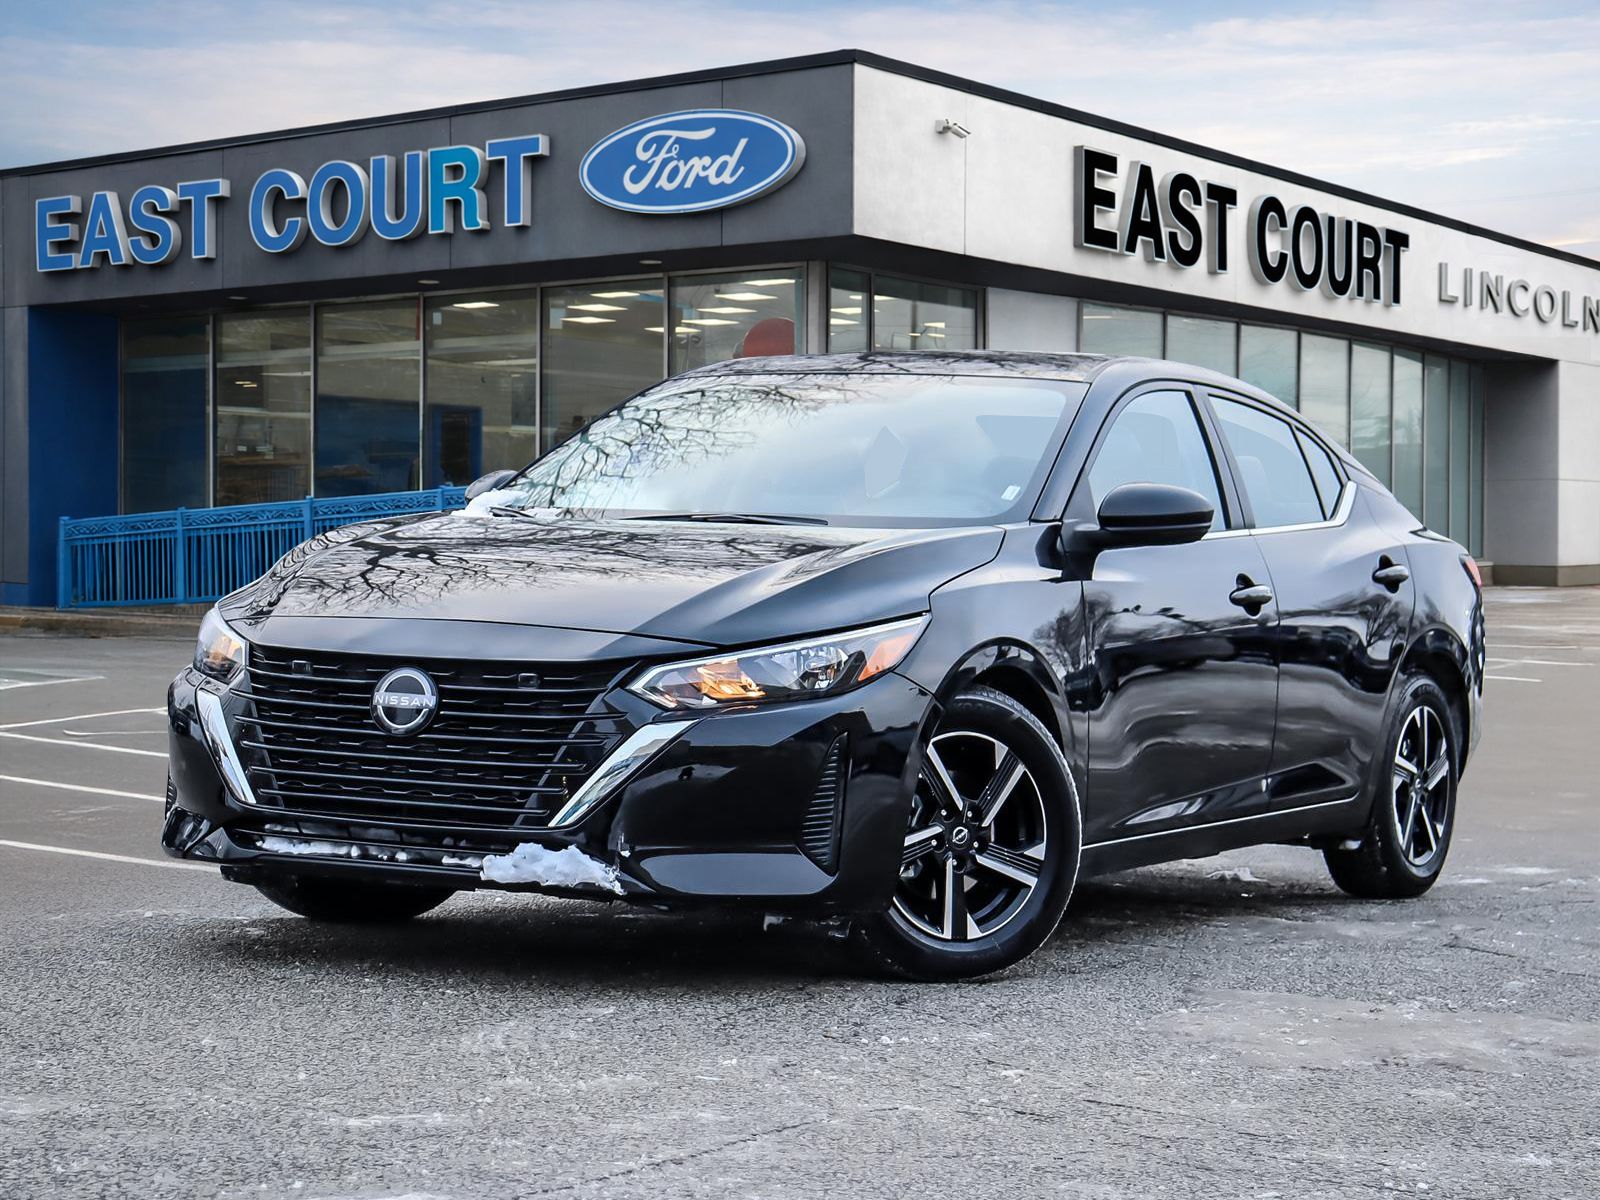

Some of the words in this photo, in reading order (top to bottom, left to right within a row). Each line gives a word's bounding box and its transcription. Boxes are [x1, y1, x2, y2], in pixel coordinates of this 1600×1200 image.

[623, 127, 748, 194] Ford
[36, 178, 231, 272] EAST
[249, 134, 550, 253] COURT
[1074, 145, 1237, 274] EAST
[1248, 194, 1410, 307] COURT
[1438, 262, 1600, 333] LINCOLN
[374, 694, 434, 707] NISSAN
